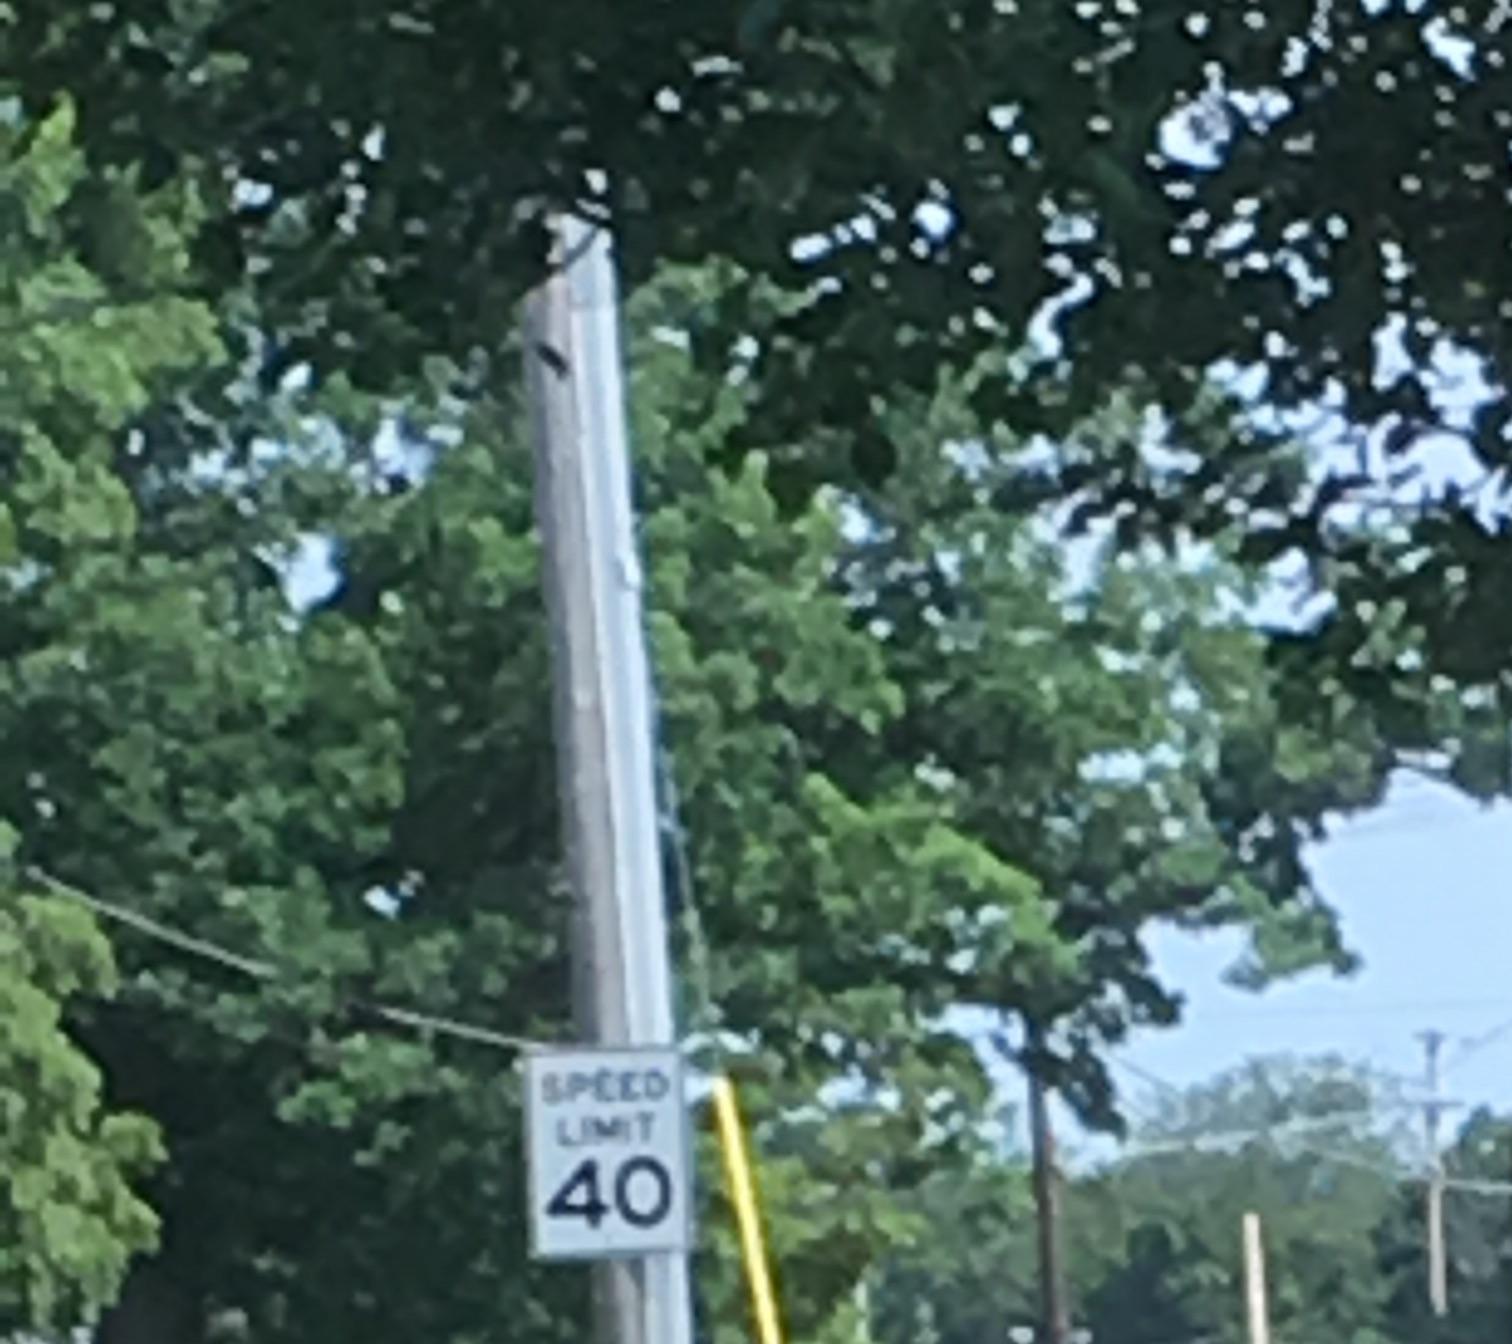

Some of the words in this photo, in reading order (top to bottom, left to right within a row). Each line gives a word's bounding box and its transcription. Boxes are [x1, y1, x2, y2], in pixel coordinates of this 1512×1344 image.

[541, 1068, 670, 1104] SPEED
[556, 1111, 655, 1146] LIMIT
[545, 1154, 672, 1230] 40
